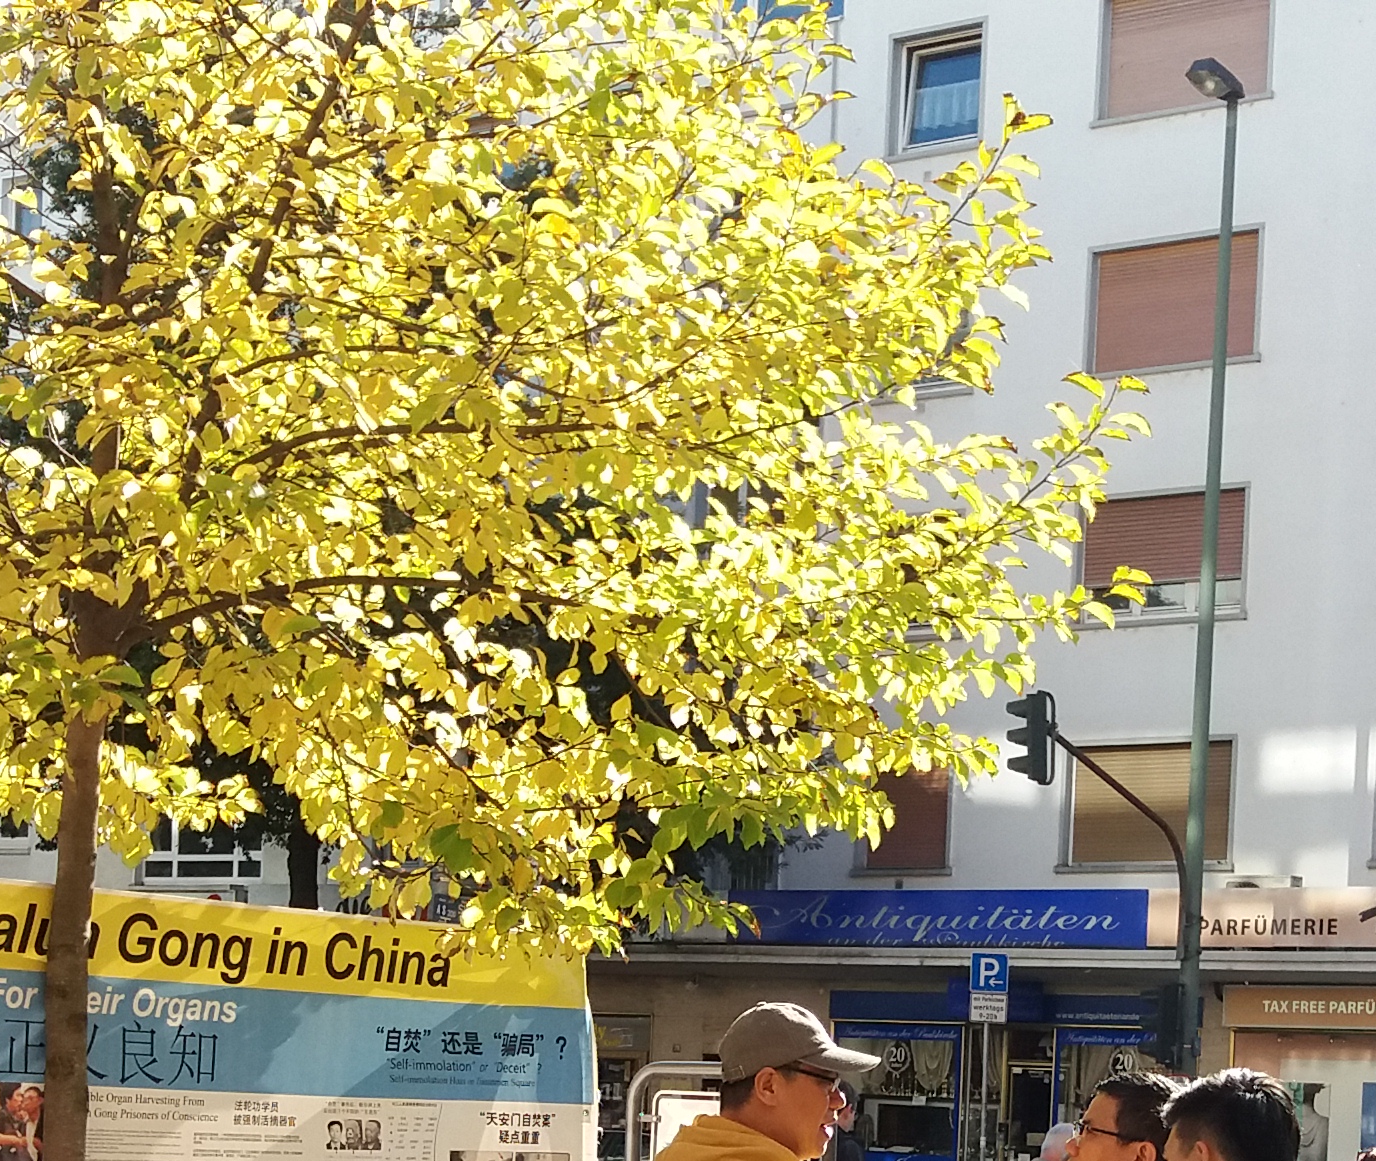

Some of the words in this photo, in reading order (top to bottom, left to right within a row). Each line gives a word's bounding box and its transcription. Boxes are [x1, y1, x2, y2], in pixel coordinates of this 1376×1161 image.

[1200, 915, 1338, 936] PARFÜMERIE
[118, 912, 253, 985] Gong
[266, 925, 307, 976] in
[325, 932, 451, 988] China
[979, 957, 1000, 987] P
[132, 988, 238, 1026] Organs
[1262, 1000, 1288, 1014] TAX
[1292, 1001, 1326, 1014] FREE
[442, 1031, 483, 1055] 还是
[889, 1047, 905, 1062] 20
[1115, 1054, 1133, 1070] 20
[106, 1093, 133, 1104] Organ
[135, 1095, 180, 1107] Harvesting
[183, 1097, 205, 1106] From
[95, 1109, 118, 1120] Gong
[120, 1109, 159, 1119] Prisoners
[162, 1111, 170, 1120] of
[172, 1112, 219, 1122] Conscience
